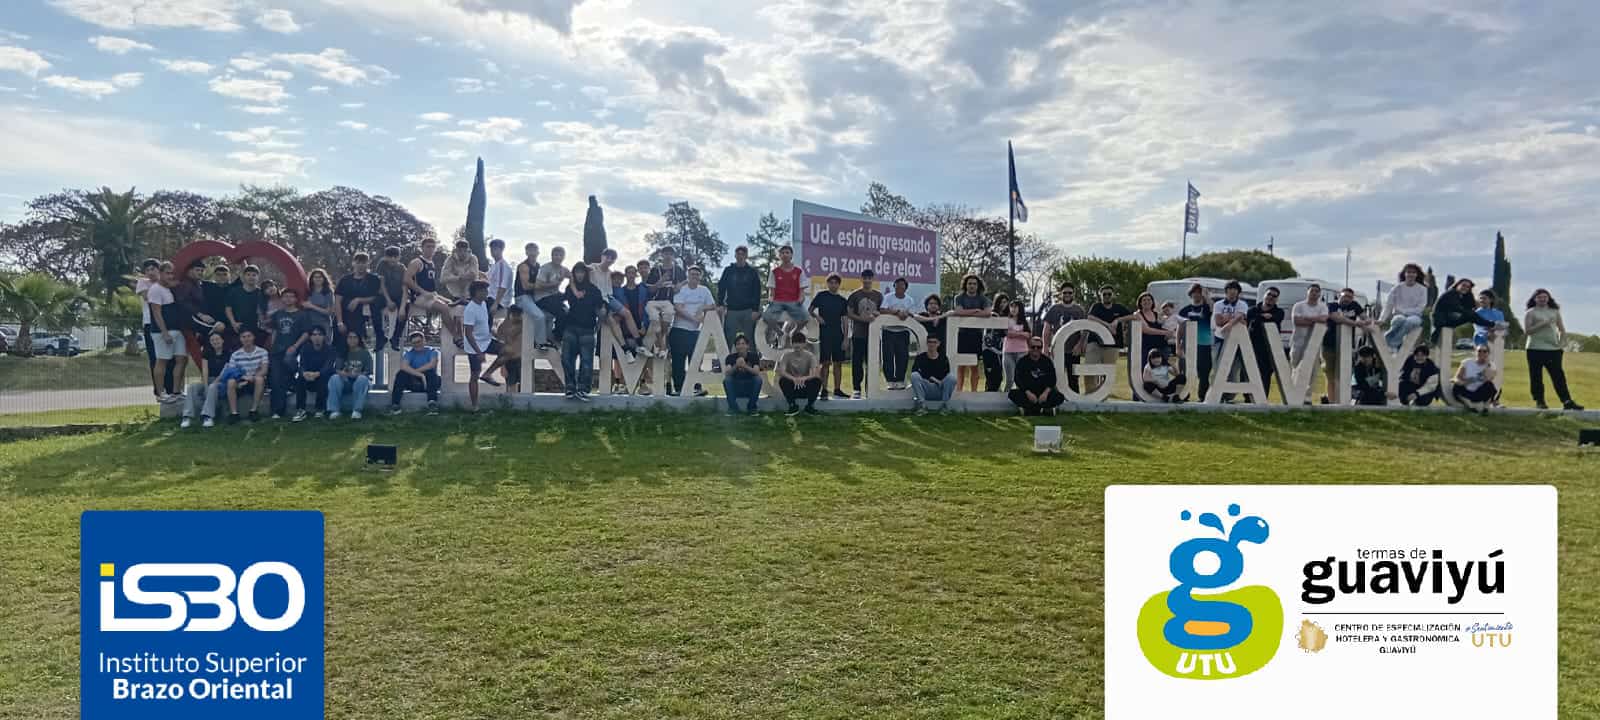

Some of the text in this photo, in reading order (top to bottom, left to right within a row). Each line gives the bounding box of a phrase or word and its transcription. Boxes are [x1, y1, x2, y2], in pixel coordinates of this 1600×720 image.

[810, 223, 931, 255] Ud. está ingresando
[820, 256, 922, 277] en zona de relax
[868, 314, 1009, 402] DE
